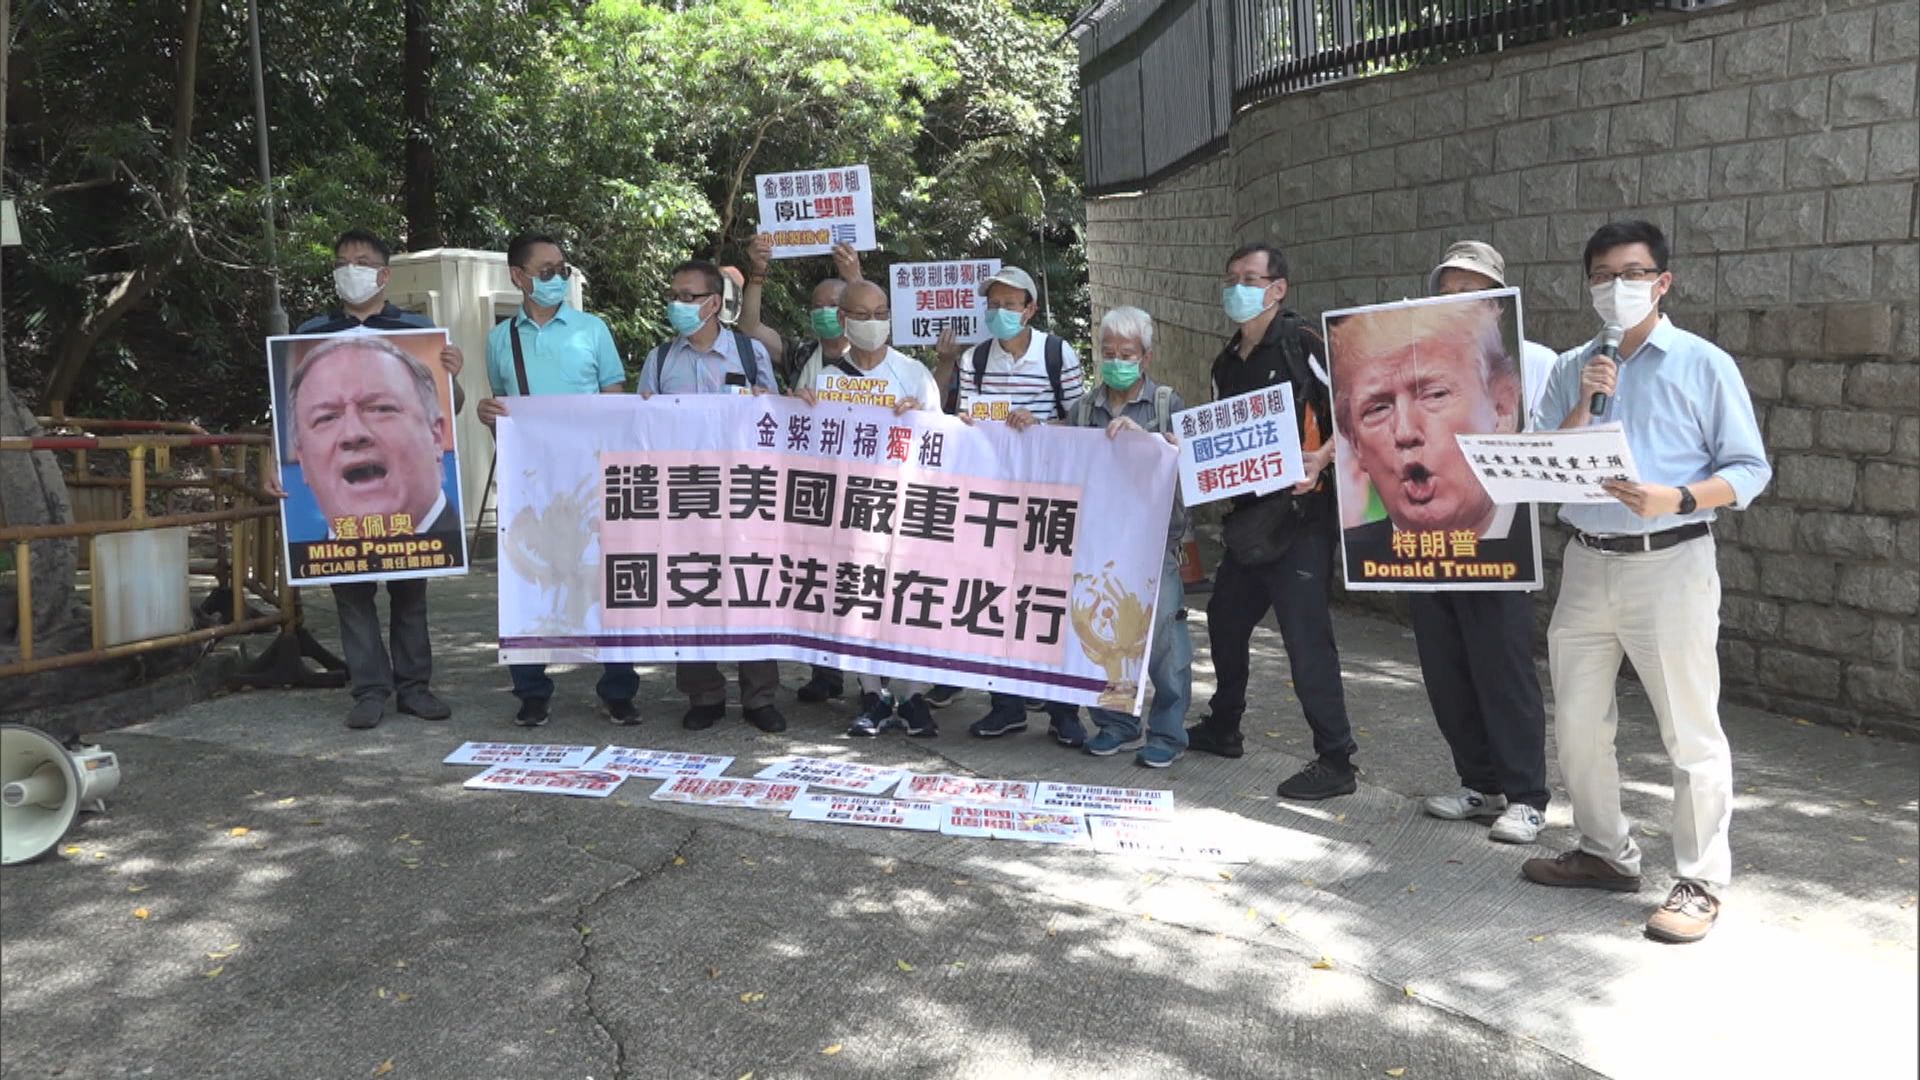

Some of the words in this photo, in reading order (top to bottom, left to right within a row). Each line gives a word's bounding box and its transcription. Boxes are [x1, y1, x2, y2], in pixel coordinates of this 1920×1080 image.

[775, 196, 855, 222] 停止雙標
[915, 288, 975, 311] 美國佬
[826, 376, 834, 389] I
[837, 377, 888, 392] CAN'T
[818, 390, 896, 407] BREATHE
[1192, 421, 1278, 462] 國安立法
[1196, 451, 1282, 492] 事在必行
[604, 463, 1079, 557] 譴責美國嚴重干預
[308, 542, 357, 559] Mike
[362, 538, 443, 556] Pompeo
[1392, 529, 1478, 558] 特朗普
[1363, 561, 1436, 577] Donald
[1440, 561, 1517, 579] Trump
[604, 552, 1067, 645] 國安立法勢在必行
